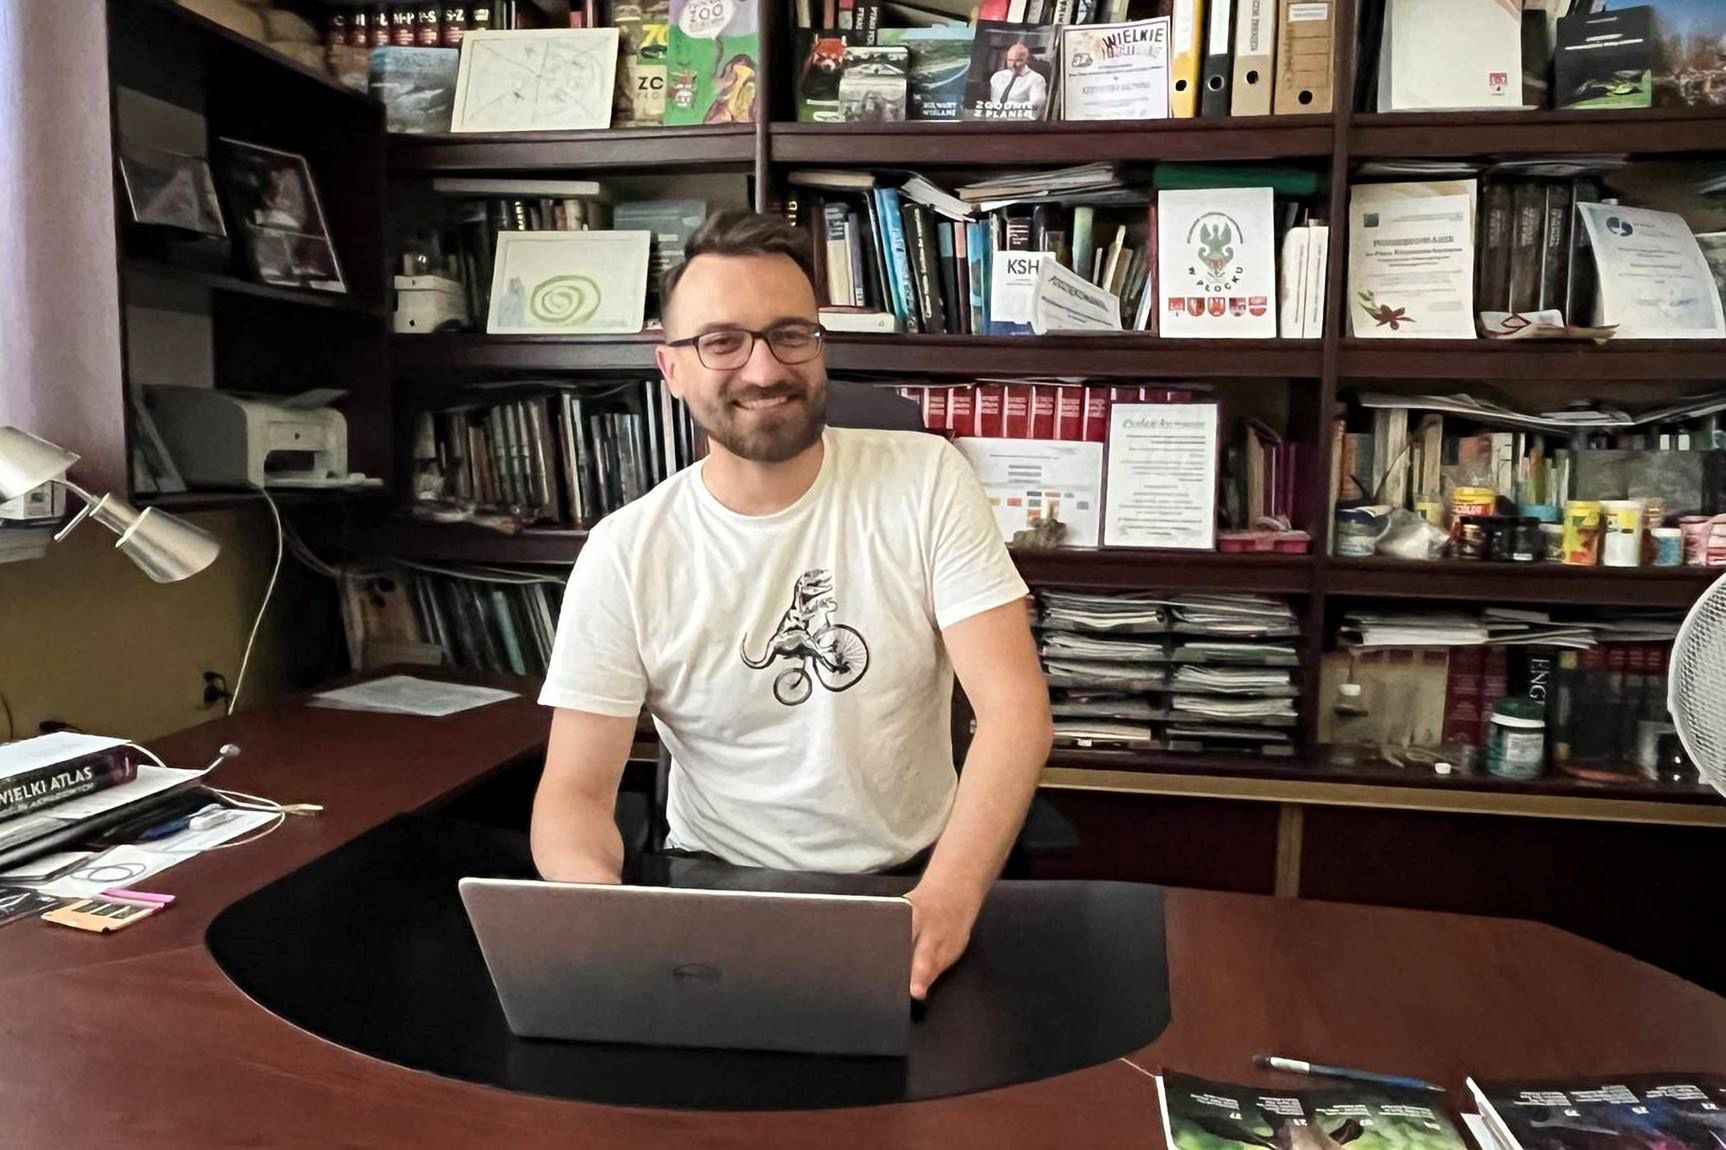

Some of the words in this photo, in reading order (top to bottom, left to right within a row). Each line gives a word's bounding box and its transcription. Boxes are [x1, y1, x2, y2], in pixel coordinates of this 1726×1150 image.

[1102, 28, 1164, 49] WIELKIE
[1007, 258, 1039, 275] KSH
[50, 766, 93, 791] ATLAS
